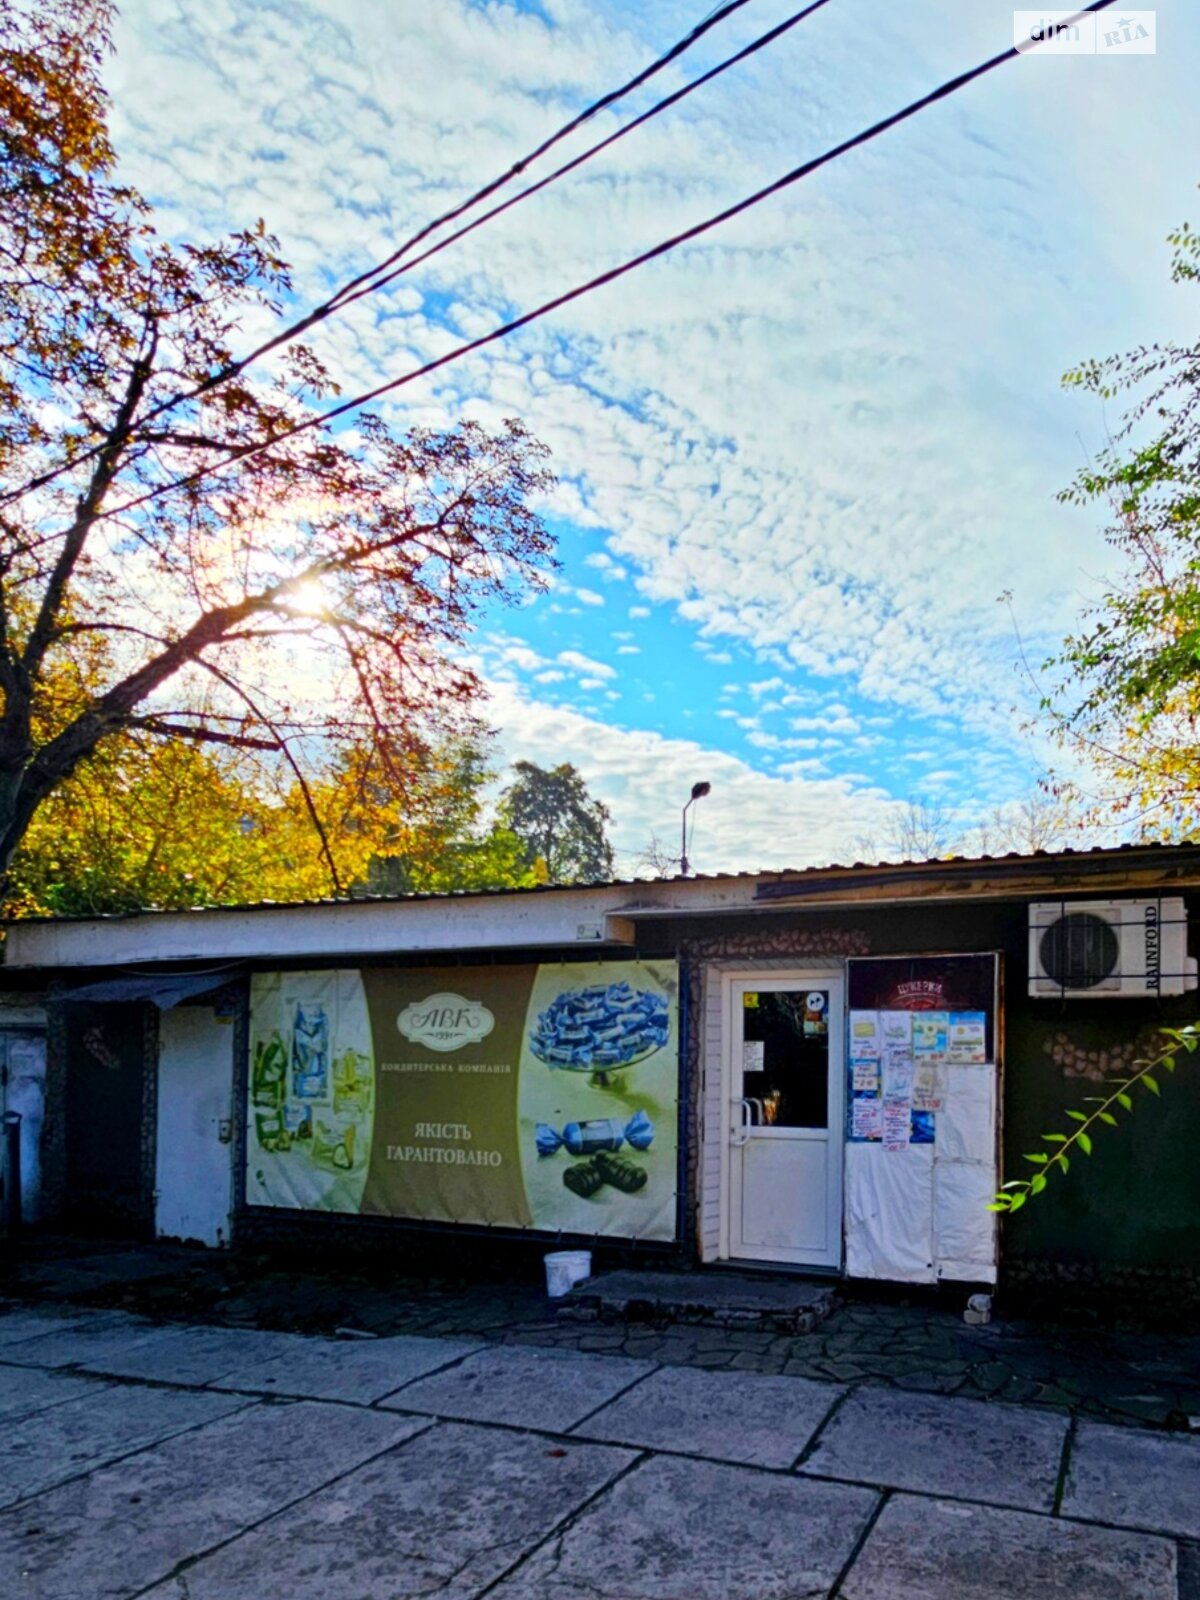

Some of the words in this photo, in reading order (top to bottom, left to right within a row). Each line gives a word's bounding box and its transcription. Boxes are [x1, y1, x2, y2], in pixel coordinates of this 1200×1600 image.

[1145, 906, 1158, 990] RAINFORD
[381, 1063, 453, 1073] КОНДИТЕРСЬКА
[458, 1063, 511, 1074] КОМПАНІЯ
[414, 1122, 471, 1140] ЯКІСТЬ
[386, 1145, 502, 1167] ГАРАНТОВАНО
